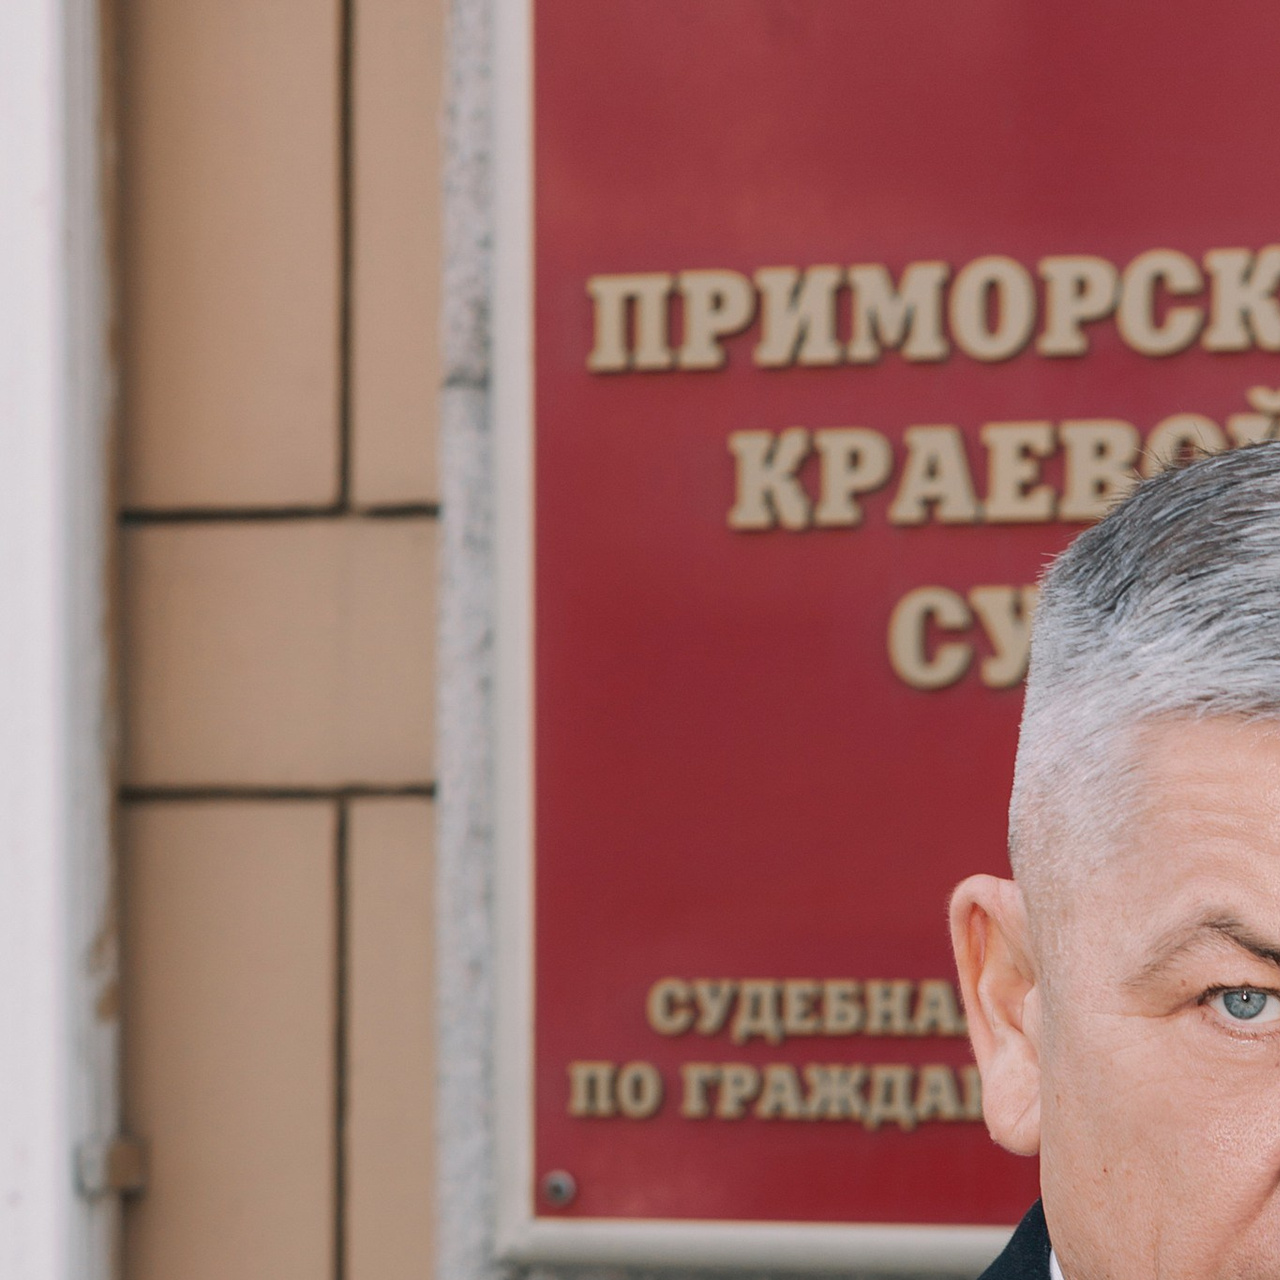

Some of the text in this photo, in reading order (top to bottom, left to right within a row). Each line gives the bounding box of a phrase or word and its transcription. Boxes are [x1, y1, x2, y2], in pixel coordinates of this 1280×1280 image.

[886, 584, 1041, 690] СУ
[646, 977, 969, 1045] СУДЕБНА
[567, 1060, 984, 1132] ПО ГРАЖДА
